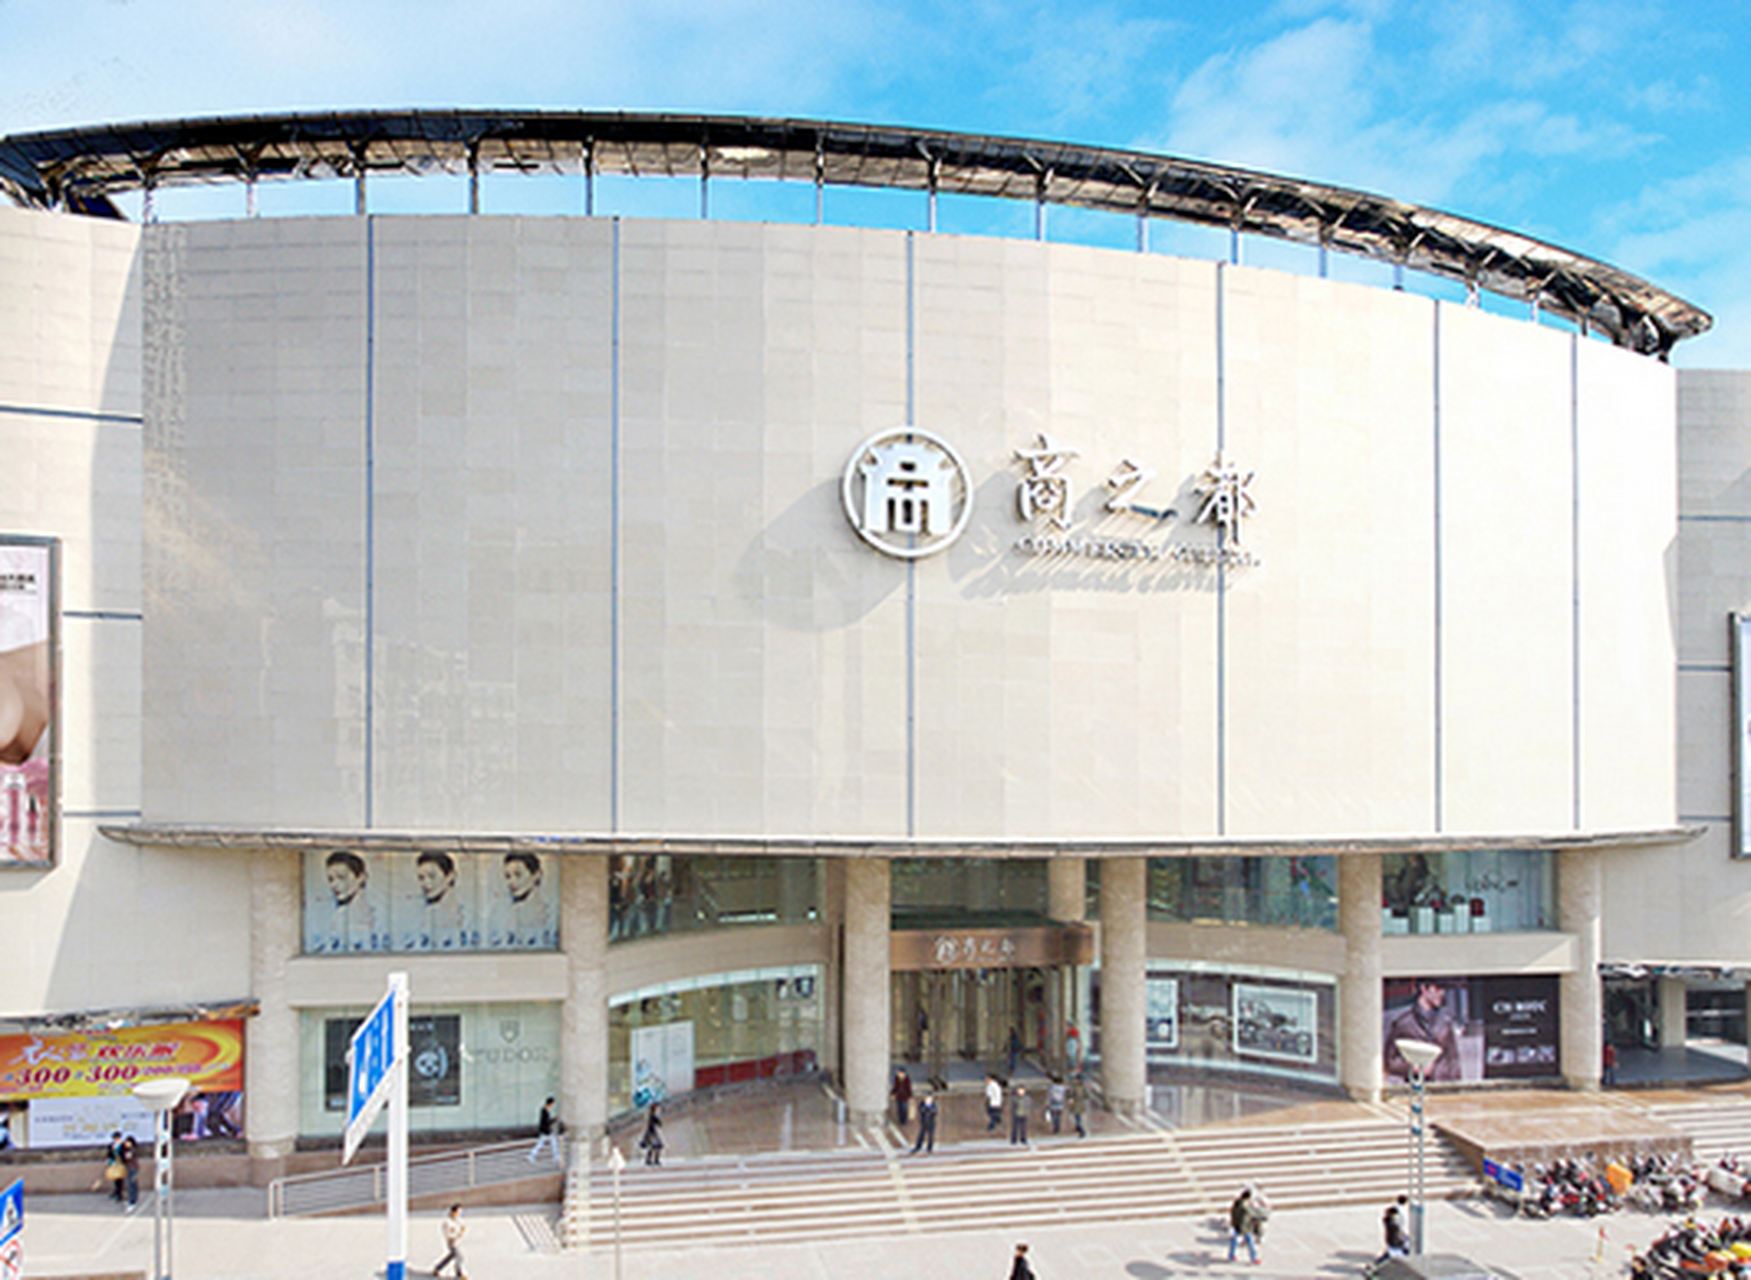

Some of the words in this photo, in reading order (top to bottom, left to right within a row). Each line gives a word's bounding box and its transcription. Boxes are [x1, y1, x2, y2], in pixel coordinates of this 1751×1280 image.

[1012, 433, 1258, 545] 商之都
[473, 1047, 549, 1063] TUDOR
